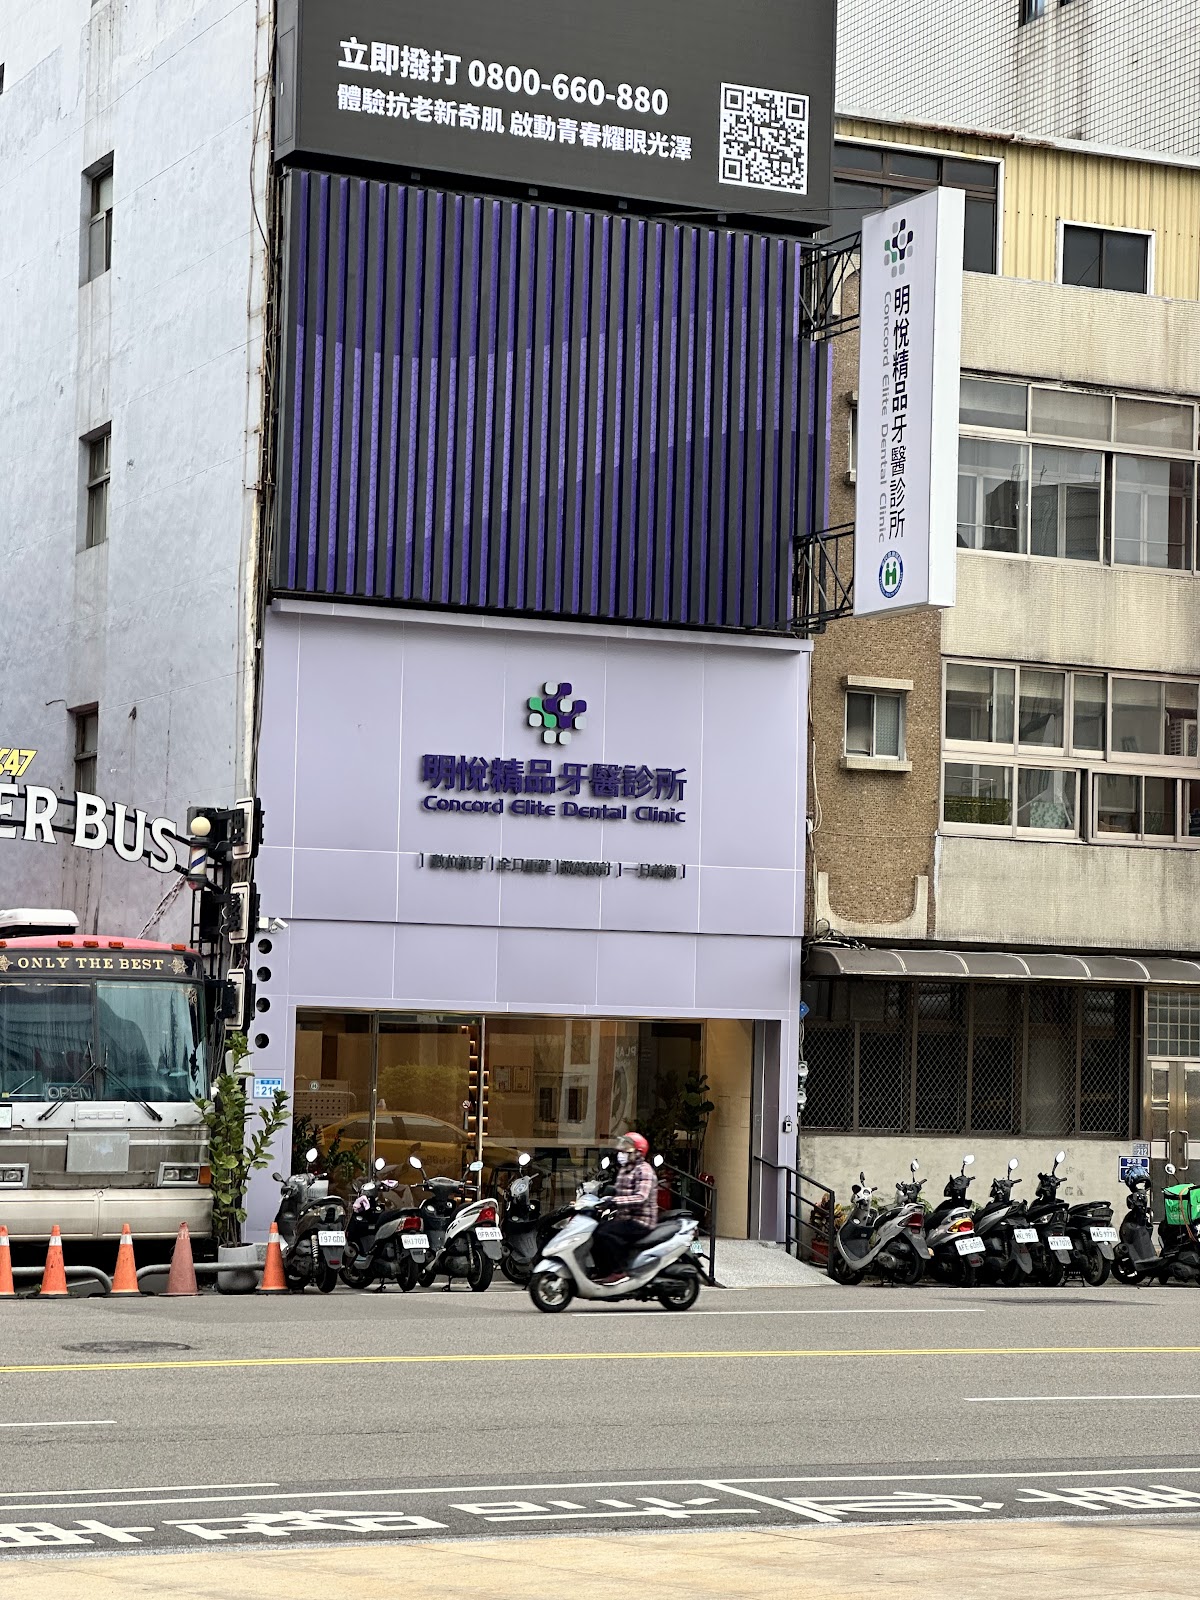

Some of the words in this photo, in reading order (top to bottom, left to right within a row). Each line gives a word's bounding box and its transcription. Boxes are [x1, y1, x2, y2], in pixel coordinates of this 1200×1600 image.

[337, 37, 462, 86] 立即撥打
[467, 59, 669, 116] 0800-660-880
[337, 83, 505, 134] 體驗抗老新奇肌
[509, 112, 693, 162] 啟動青春耀眼光澤
[883, 291, 891, 367] Concord
[889, 284, 910, 540] 明悅精品牙醫診所
[880, 424, 888, 484] Dental
[422, 754, 687, 800] 明悅精品牙醫診所
[72, 791, 177, 873] BUS
[423, 796, 503, 814] Concord
[510, 799, 556, 816] Elite
[562, 801, 627, 819] Dental
[634, 805, 686, 822] Clinic
[17, 957, 69, 969] ONLY
[75, 958, 114, 969] THE
[119, 959, 164, 970] BEST
[48, 1086, 92, 1099] OPEN
[261, 1086, 280, 1096] 21
